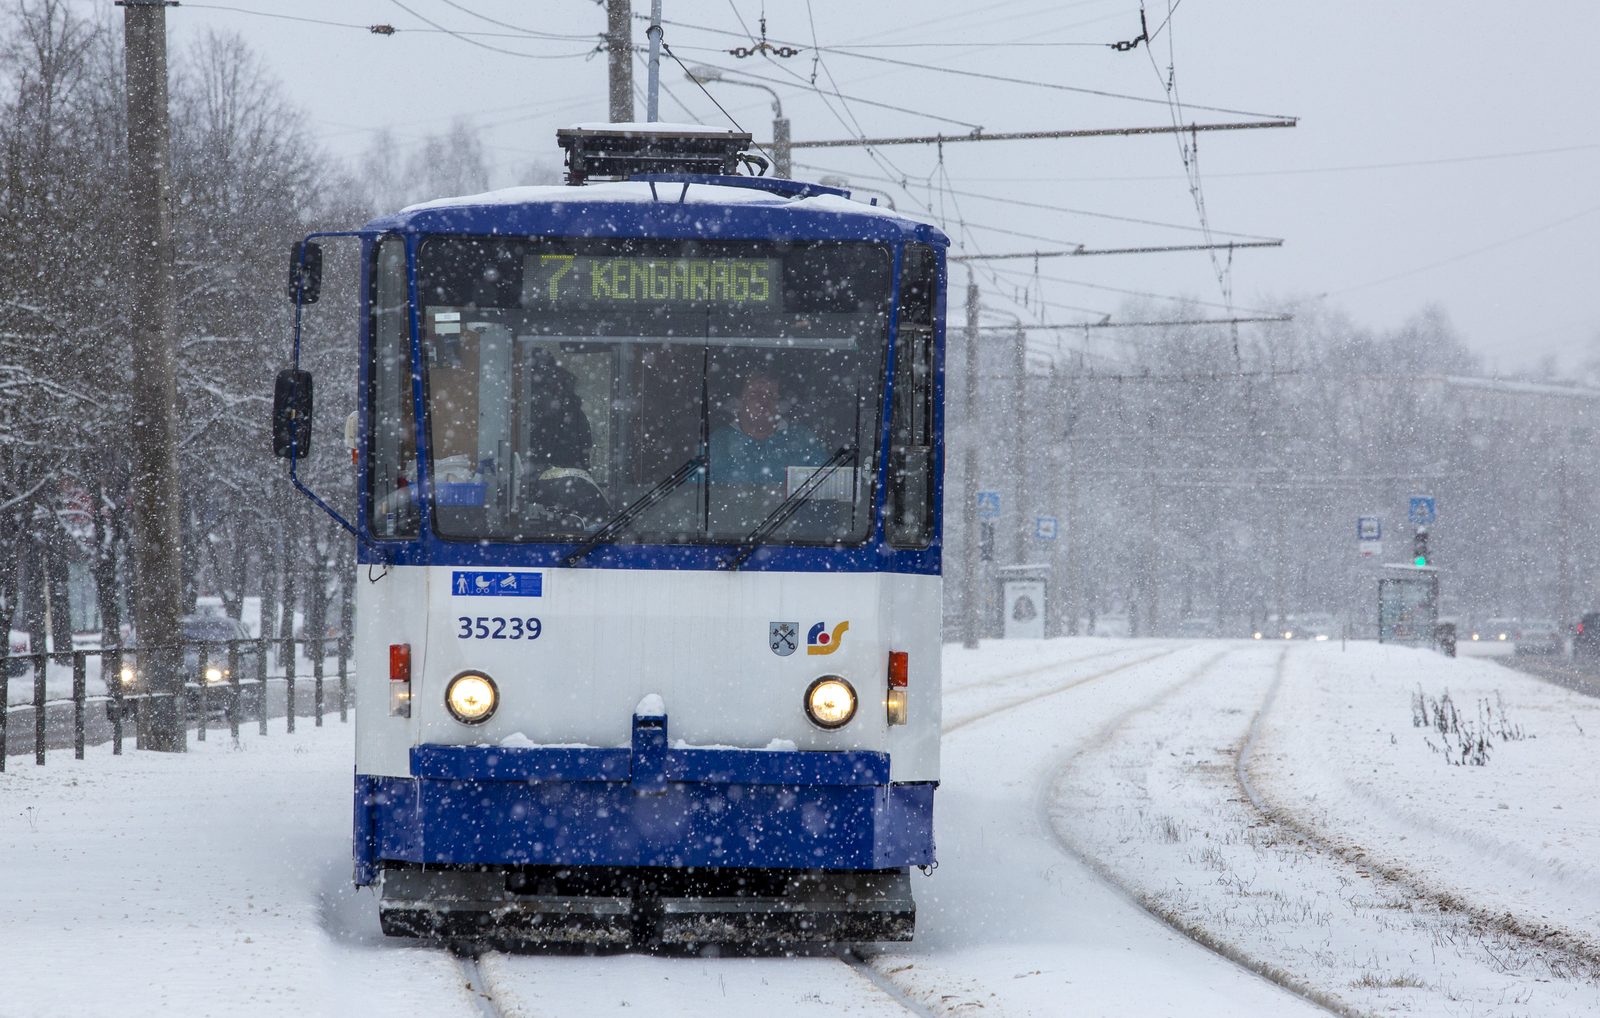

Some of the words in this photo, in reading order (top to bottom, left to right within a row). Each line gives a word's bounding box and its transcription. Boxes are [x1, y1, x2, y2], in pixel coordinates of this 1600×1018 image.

[541, 254, 575, 301] 7
[591, 258, 769, 301] KENGARAGS
[457, 616, 542, 640] 35239
